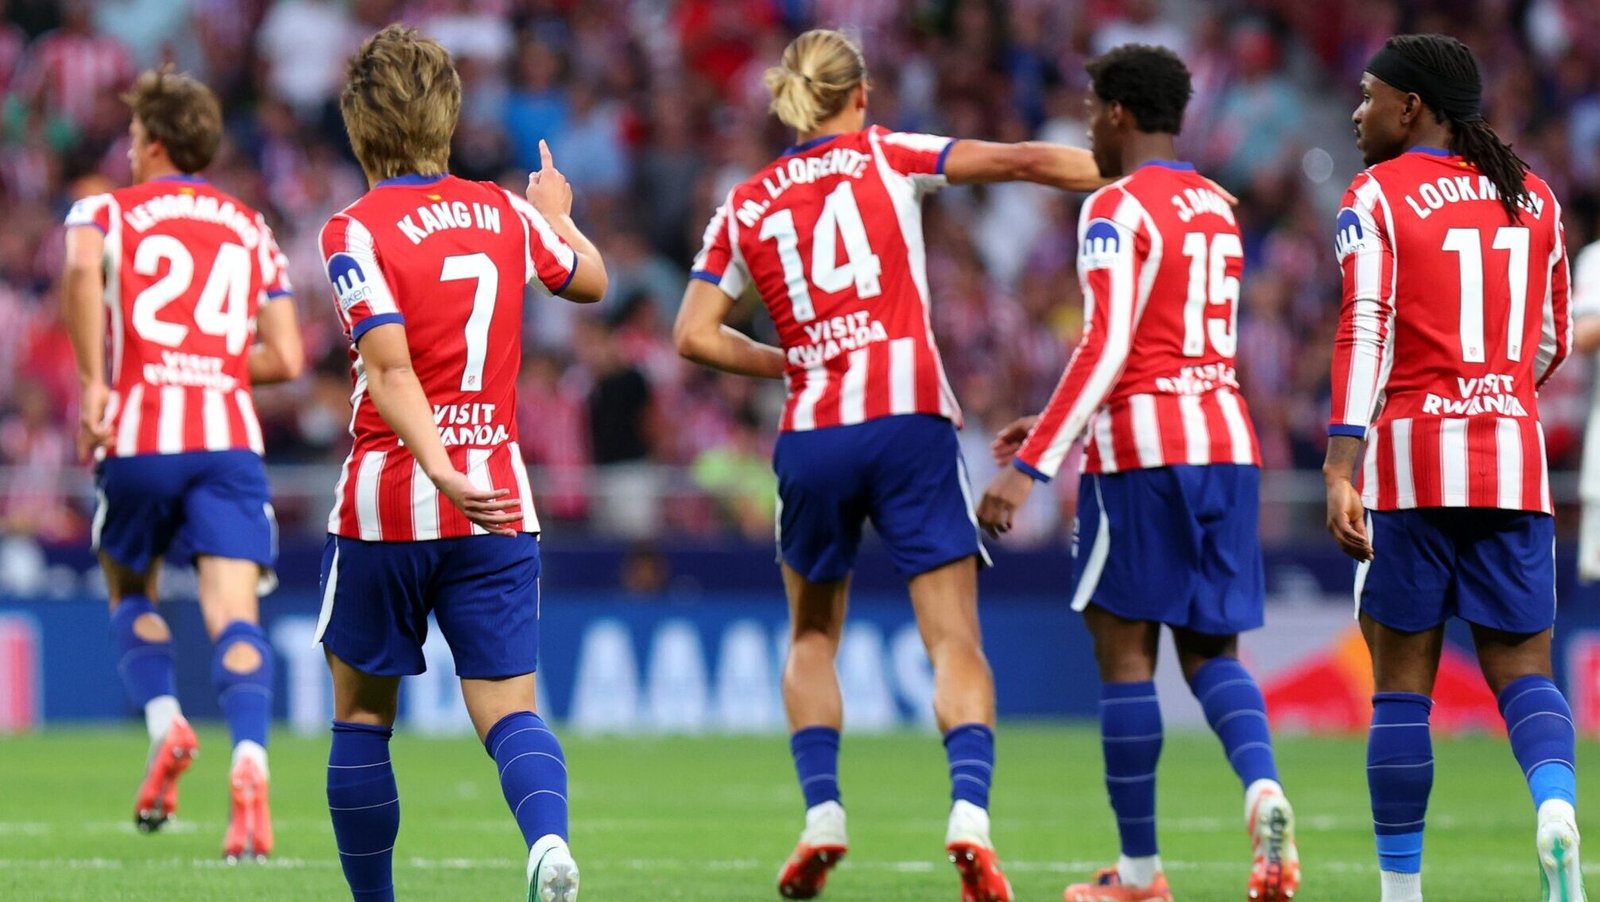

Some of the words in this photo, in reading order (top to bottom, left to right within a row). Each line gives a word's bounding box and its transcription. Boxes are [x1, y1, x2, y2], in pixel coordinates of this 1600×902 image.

[736, 198, 771, 228] M.
[762, 148, 872, 200] LLORENTE
[1404, 175, 1544, 220] LOOKMN
[397, 201, 472, 245] KANG
[474, 202, 501, 234] IN
[758, 180, 882, 323] 14
[132, 234, 252, 355] 24
[341, 285, 373, 312] aken
[1182, 232, 1243, 358] 15
[1441, 226, 1530, 363] 11
[440, 252, 499, 392] 7
[804, 310, 870, 345] VISIT
[1422, 392, 1529, 417] RWANDA
[1457, 373, 1515, 399] VISIT
[397, 424, 509, 448] ANDA
[432, 402, 496, 426] VISIT
